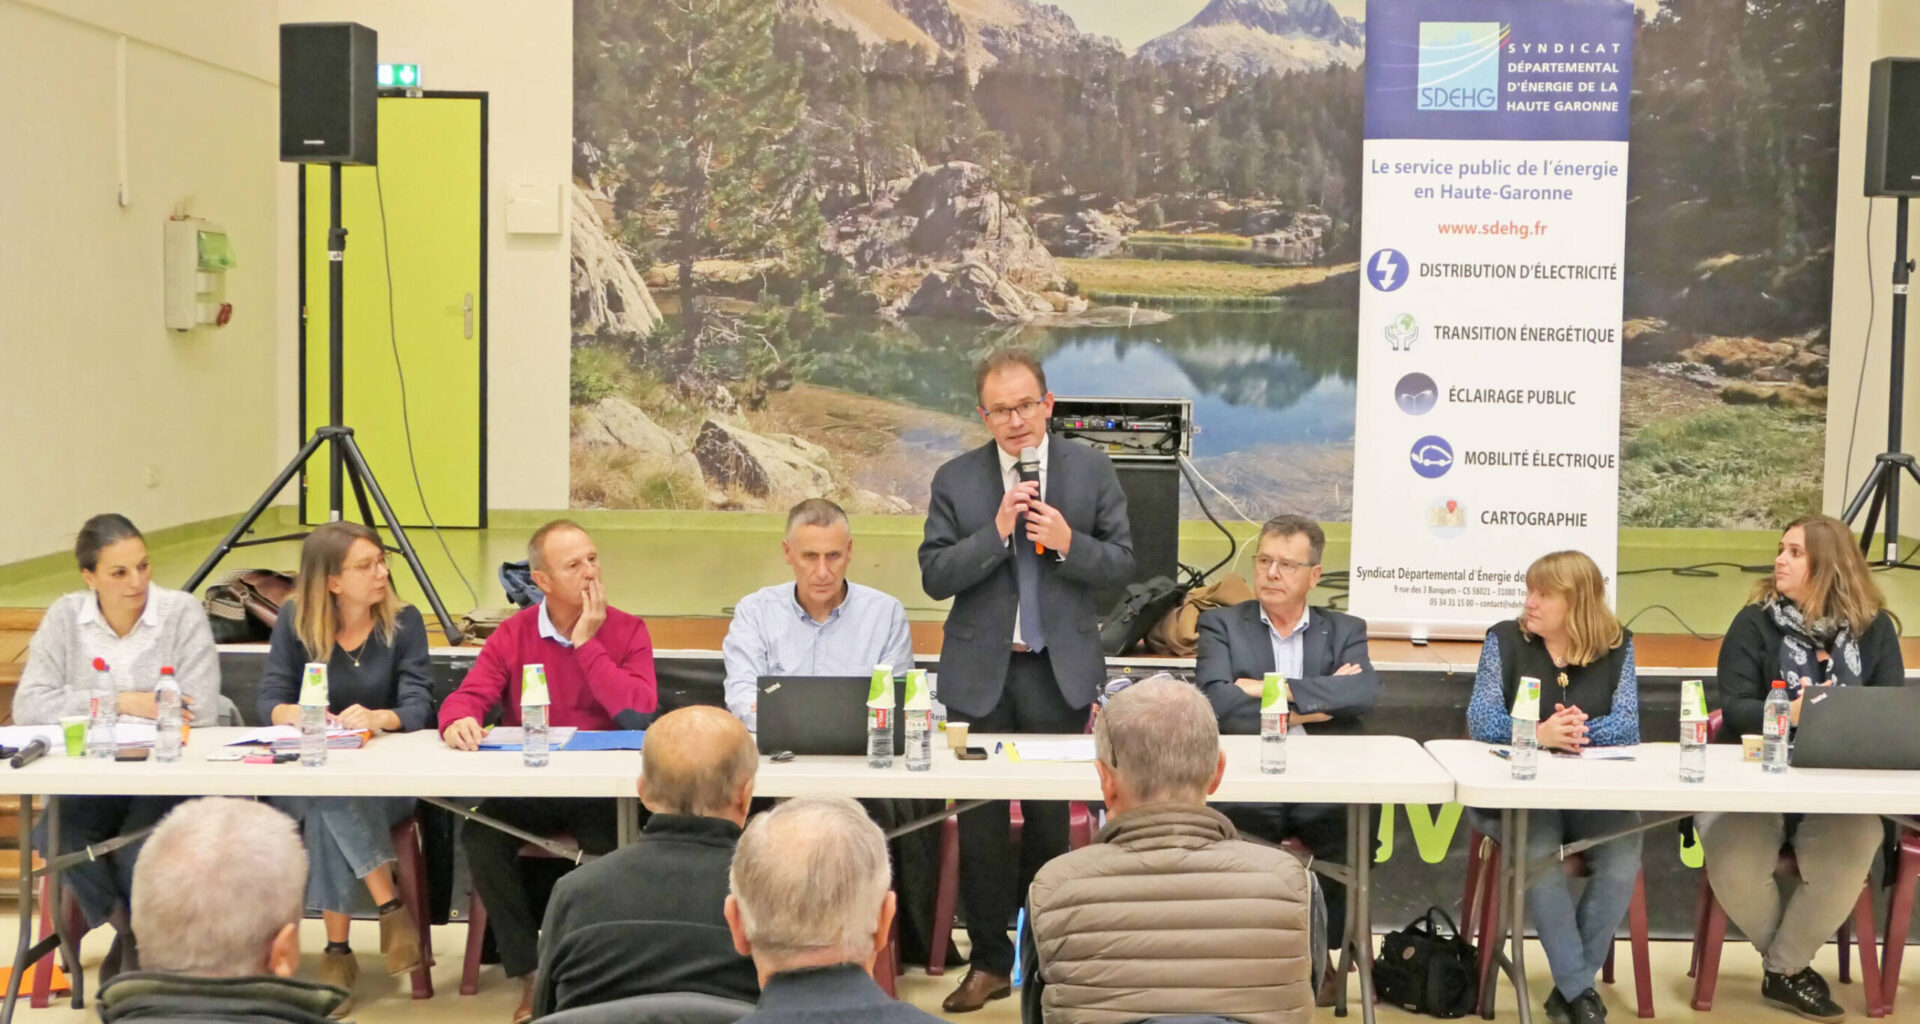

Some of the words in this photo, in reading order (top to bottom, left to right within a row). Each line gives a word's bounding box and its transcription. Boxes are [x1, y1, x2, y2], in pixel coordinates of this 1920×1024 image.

[1507, 43, 1621, 54] SYNDICAT
[1507, 61, 1619, 73] DÉPARTEMENTAL
[1507, 81, 1573, 92] D'ÉNERGIE
[1578, 82, 1595, 92] DE
[1600, 82, 1618, 92] LA
[1421, 88, 1496, 108] SDEHG
[1506, 101, 1550, 111] HAUTE
[1554, 101, 1619, 111] GARONNE
[1371, 159, 1389, 174] Le
[1394, 160, 1453, 174] service
[1458, 159, 1510, 179] public
[1517, 160, 1538, 175] de
[1543, 160, 1619, 180] l'énergie
[1414, 187, 1434, 199] en
[1441, 185, 1573, 200] Haute-Garonne
[1437, 221, 1548, 239] www.sdehg.fr
[1419, 263, 1516, 278] DISTRIBUTION
[1434, 325, 1516, 341] TRANSITION
[1520, 324, 1615, 344] ÉNERGÉTIQUE
[1449, 387, 1524, 403] ÉCLAIRAGE
[1528, 390, 1576, 404] PUBLIC
[1464, 450, 1528, 466] MOBILITÉ
[1532, 450, 1615, 470] ÉLECTRIQUE
[1481, 511, 1588, 527] CARTOGRAPHIE
[1357, 566, 1395, 581] Syndicat
[1398, 567, 1466, 582] Départemental
[1468, 567, 1512, 585] d'Énergie
[1513, 570, 1526, 582] de
[1428, 586, 1456, 595] Banquets
[1462, 587, 1471, 595] CS
